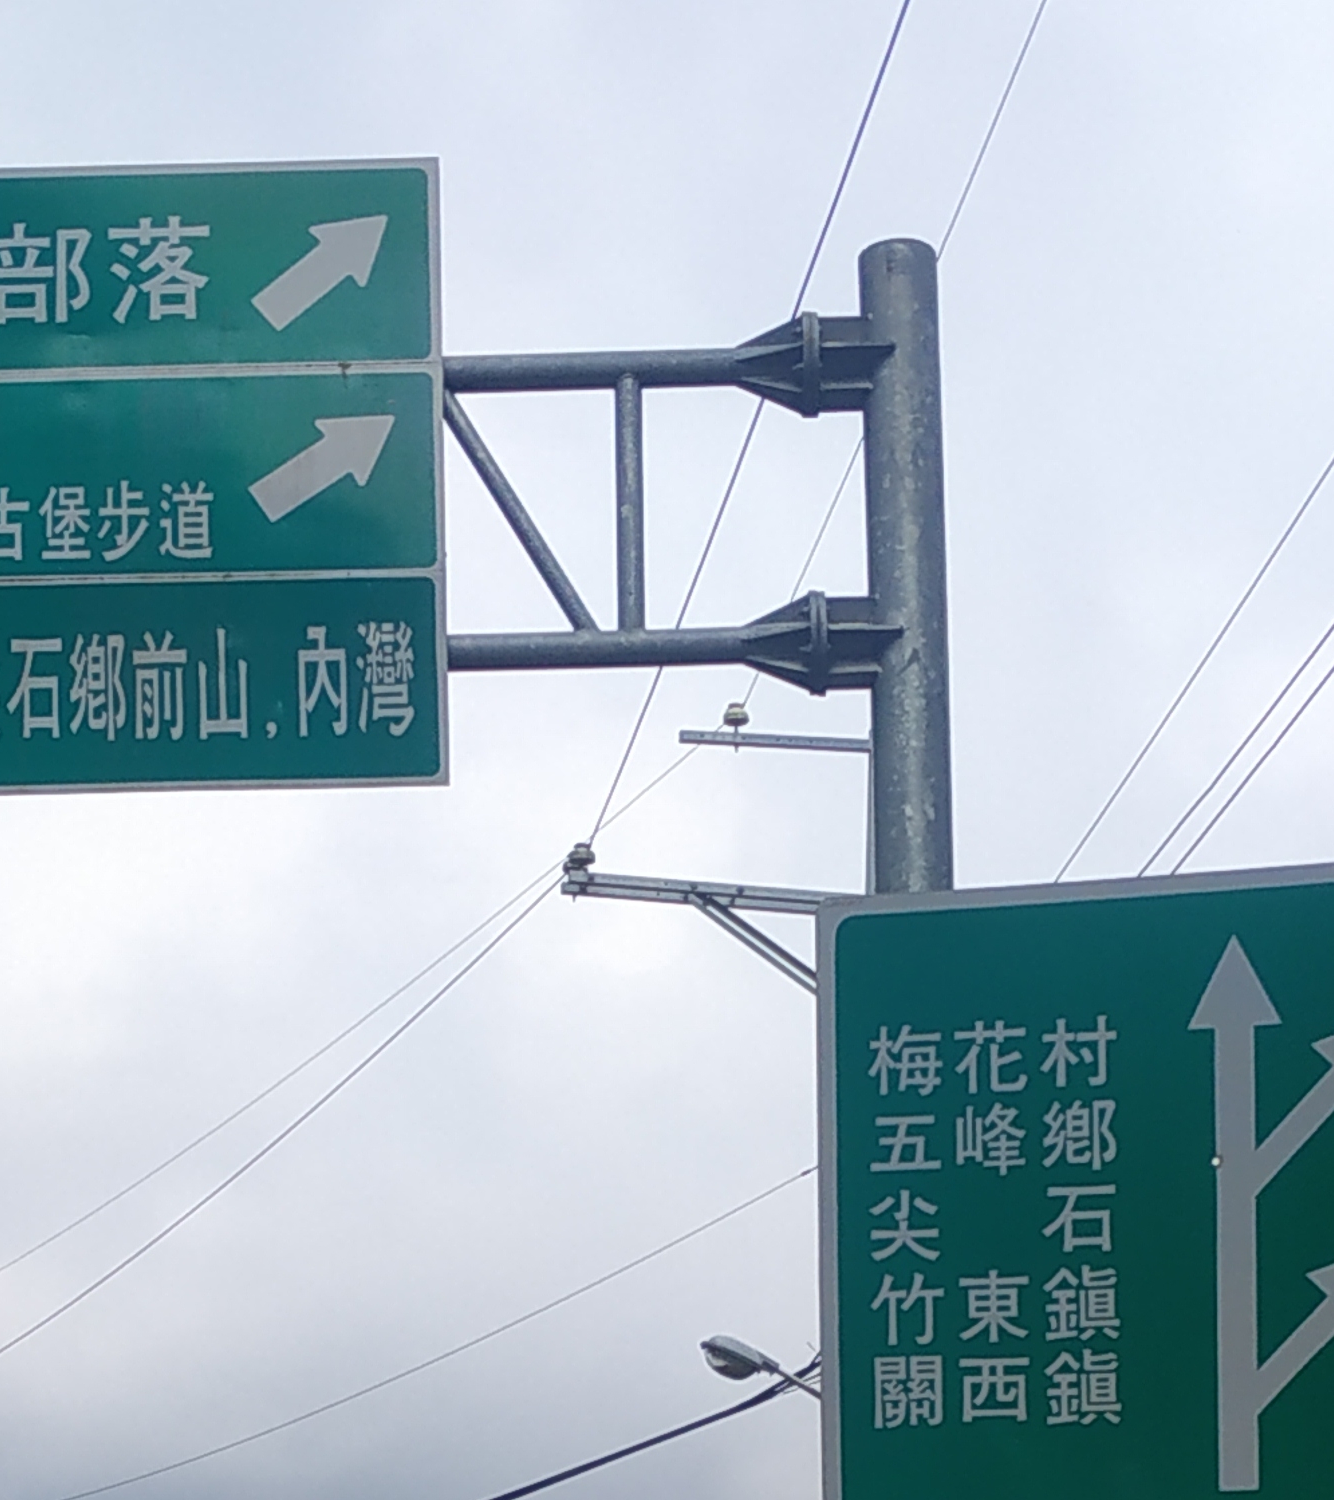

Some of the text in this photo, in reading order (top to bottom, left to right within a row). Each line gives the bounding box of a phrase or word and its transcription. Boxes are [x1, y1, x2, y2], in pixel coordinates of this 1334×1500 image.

[868, 1015, 1117, 1096] 梅花村
[870, 1099, 1117, 1177] 五峰鄉
